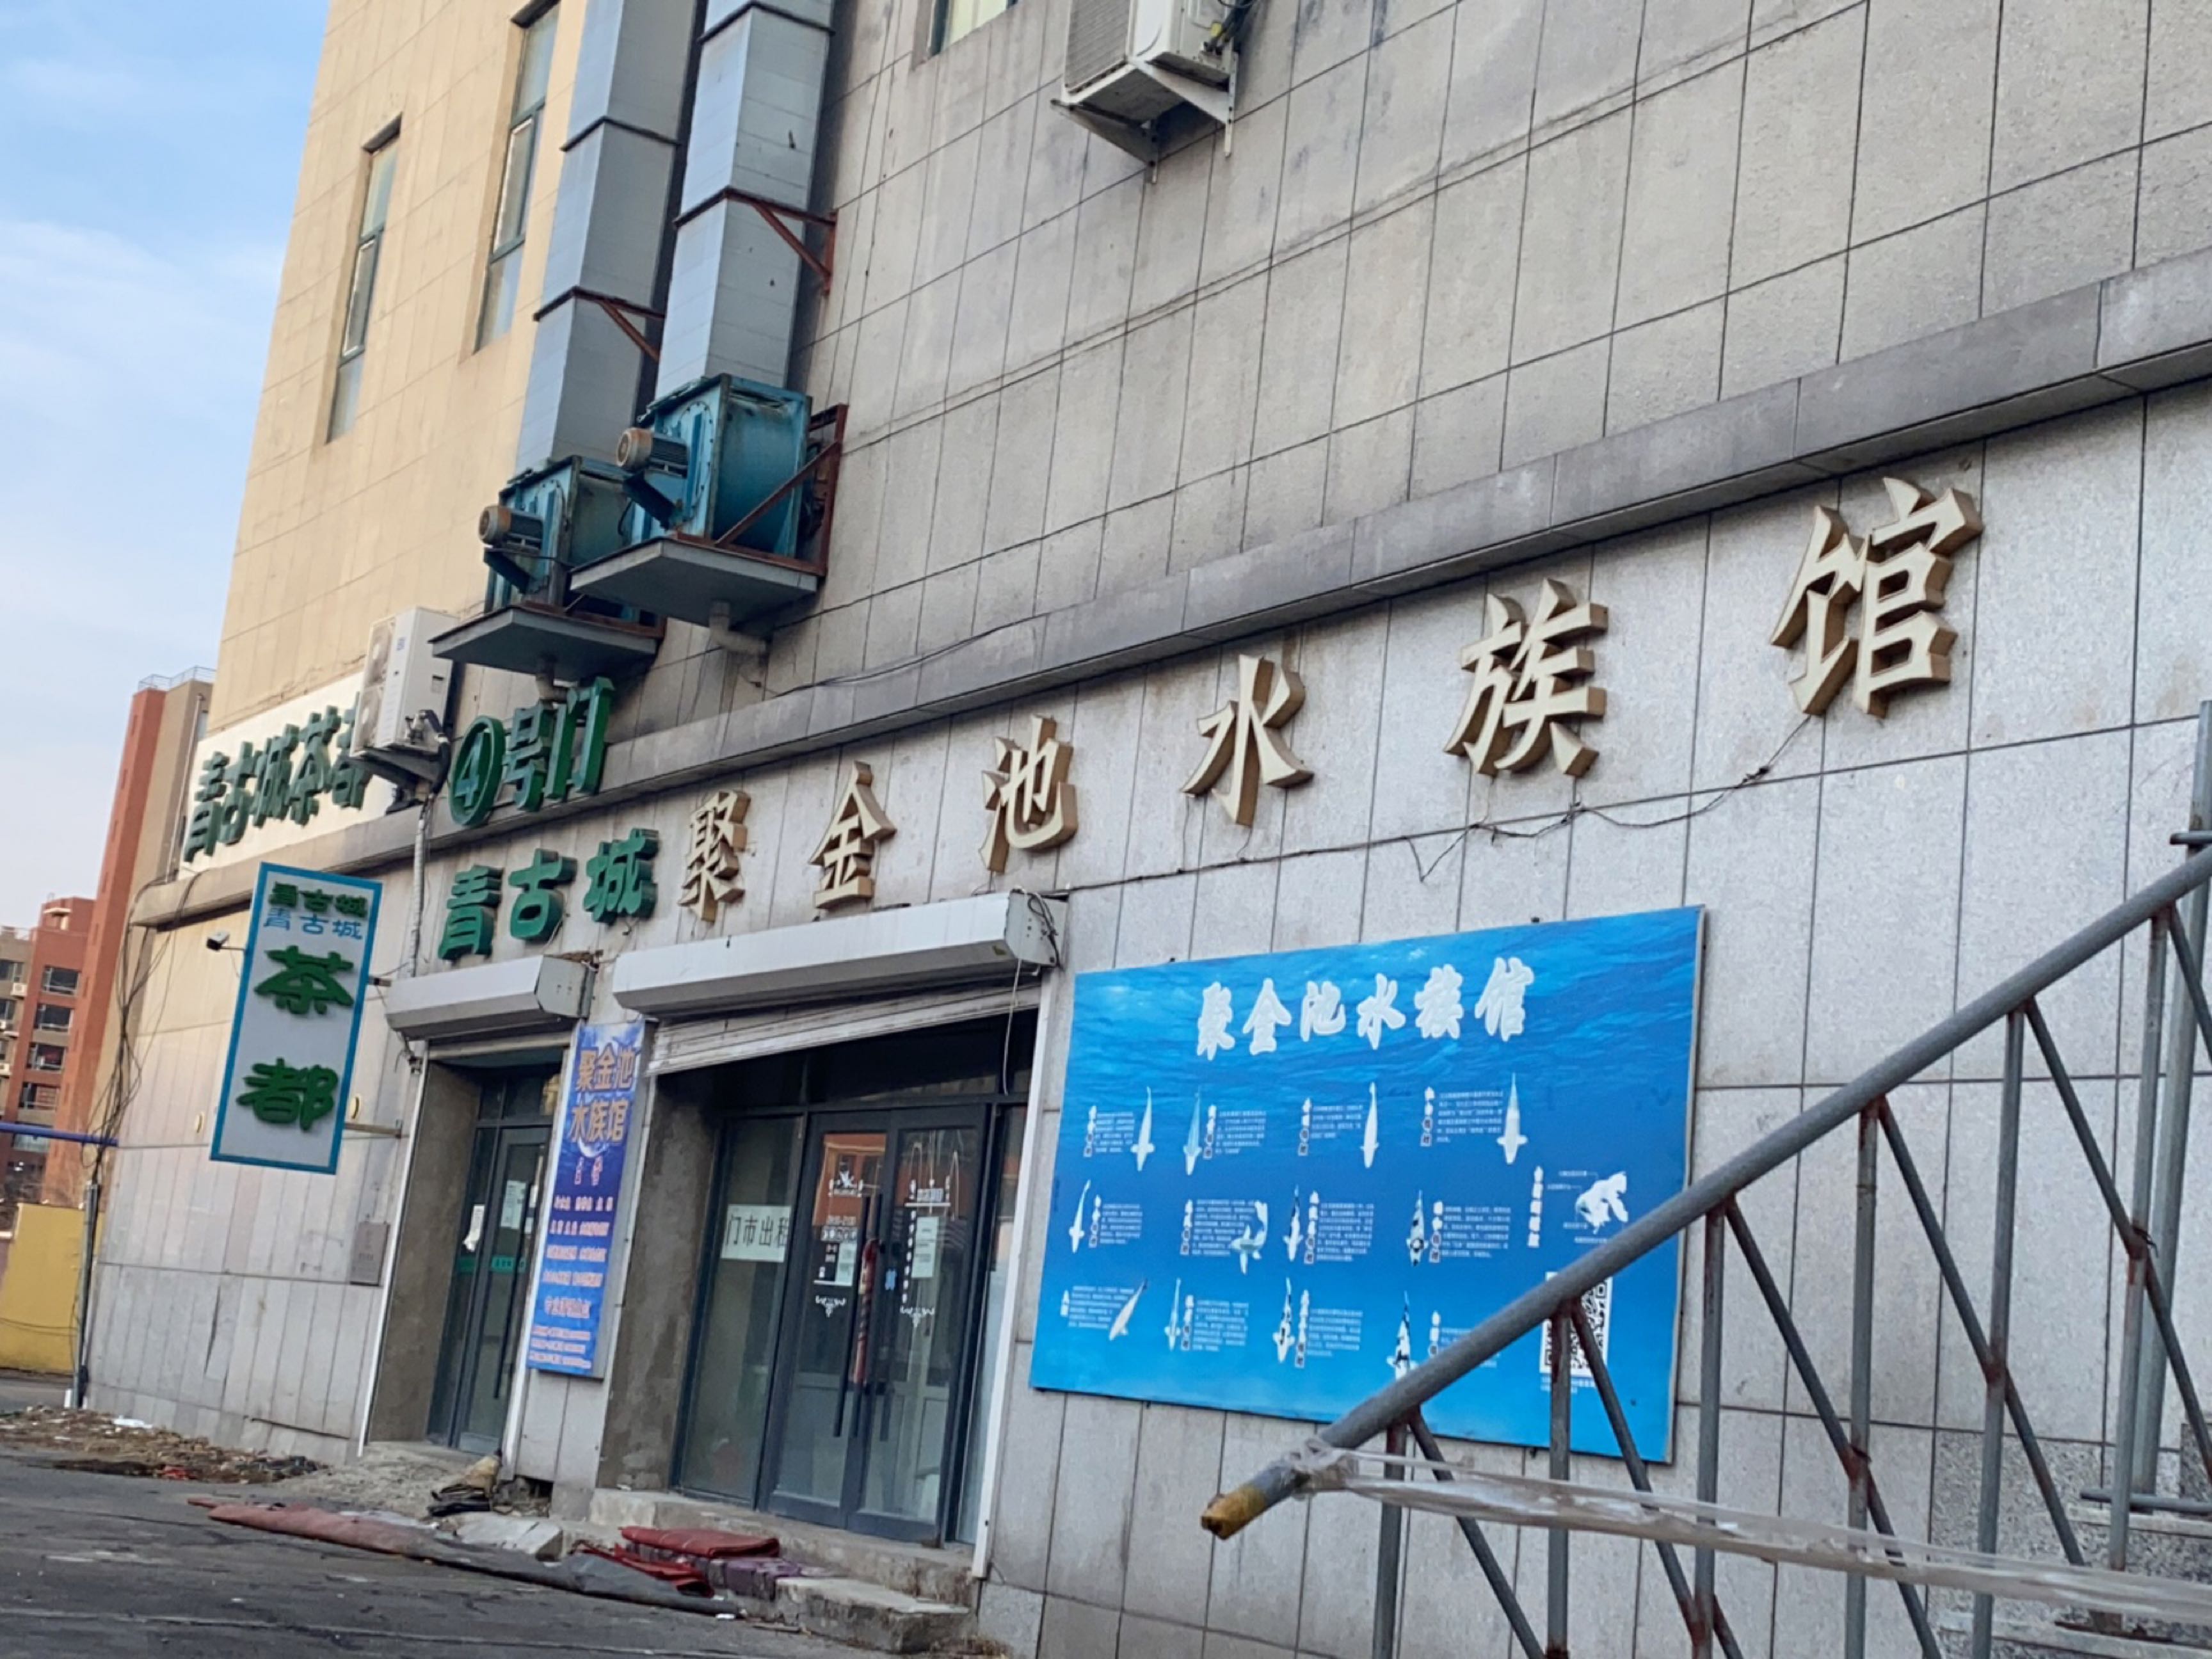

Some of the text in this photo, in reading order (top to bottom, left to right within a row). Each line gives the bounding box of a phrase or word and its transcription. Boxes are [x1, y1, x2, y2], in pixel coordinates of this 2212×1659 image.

[678, 476, 1984, 922] 聚金池水族馆
[437, 828, 659, 960] 青古城
[236, 944, 355, 1132] 茶都
[577, 1043, 637, 1091] 聚金池
[1196, 956, 1534, 1061] 聚金池水族馆
[568, 1092, 629, 1142] 水族馆
